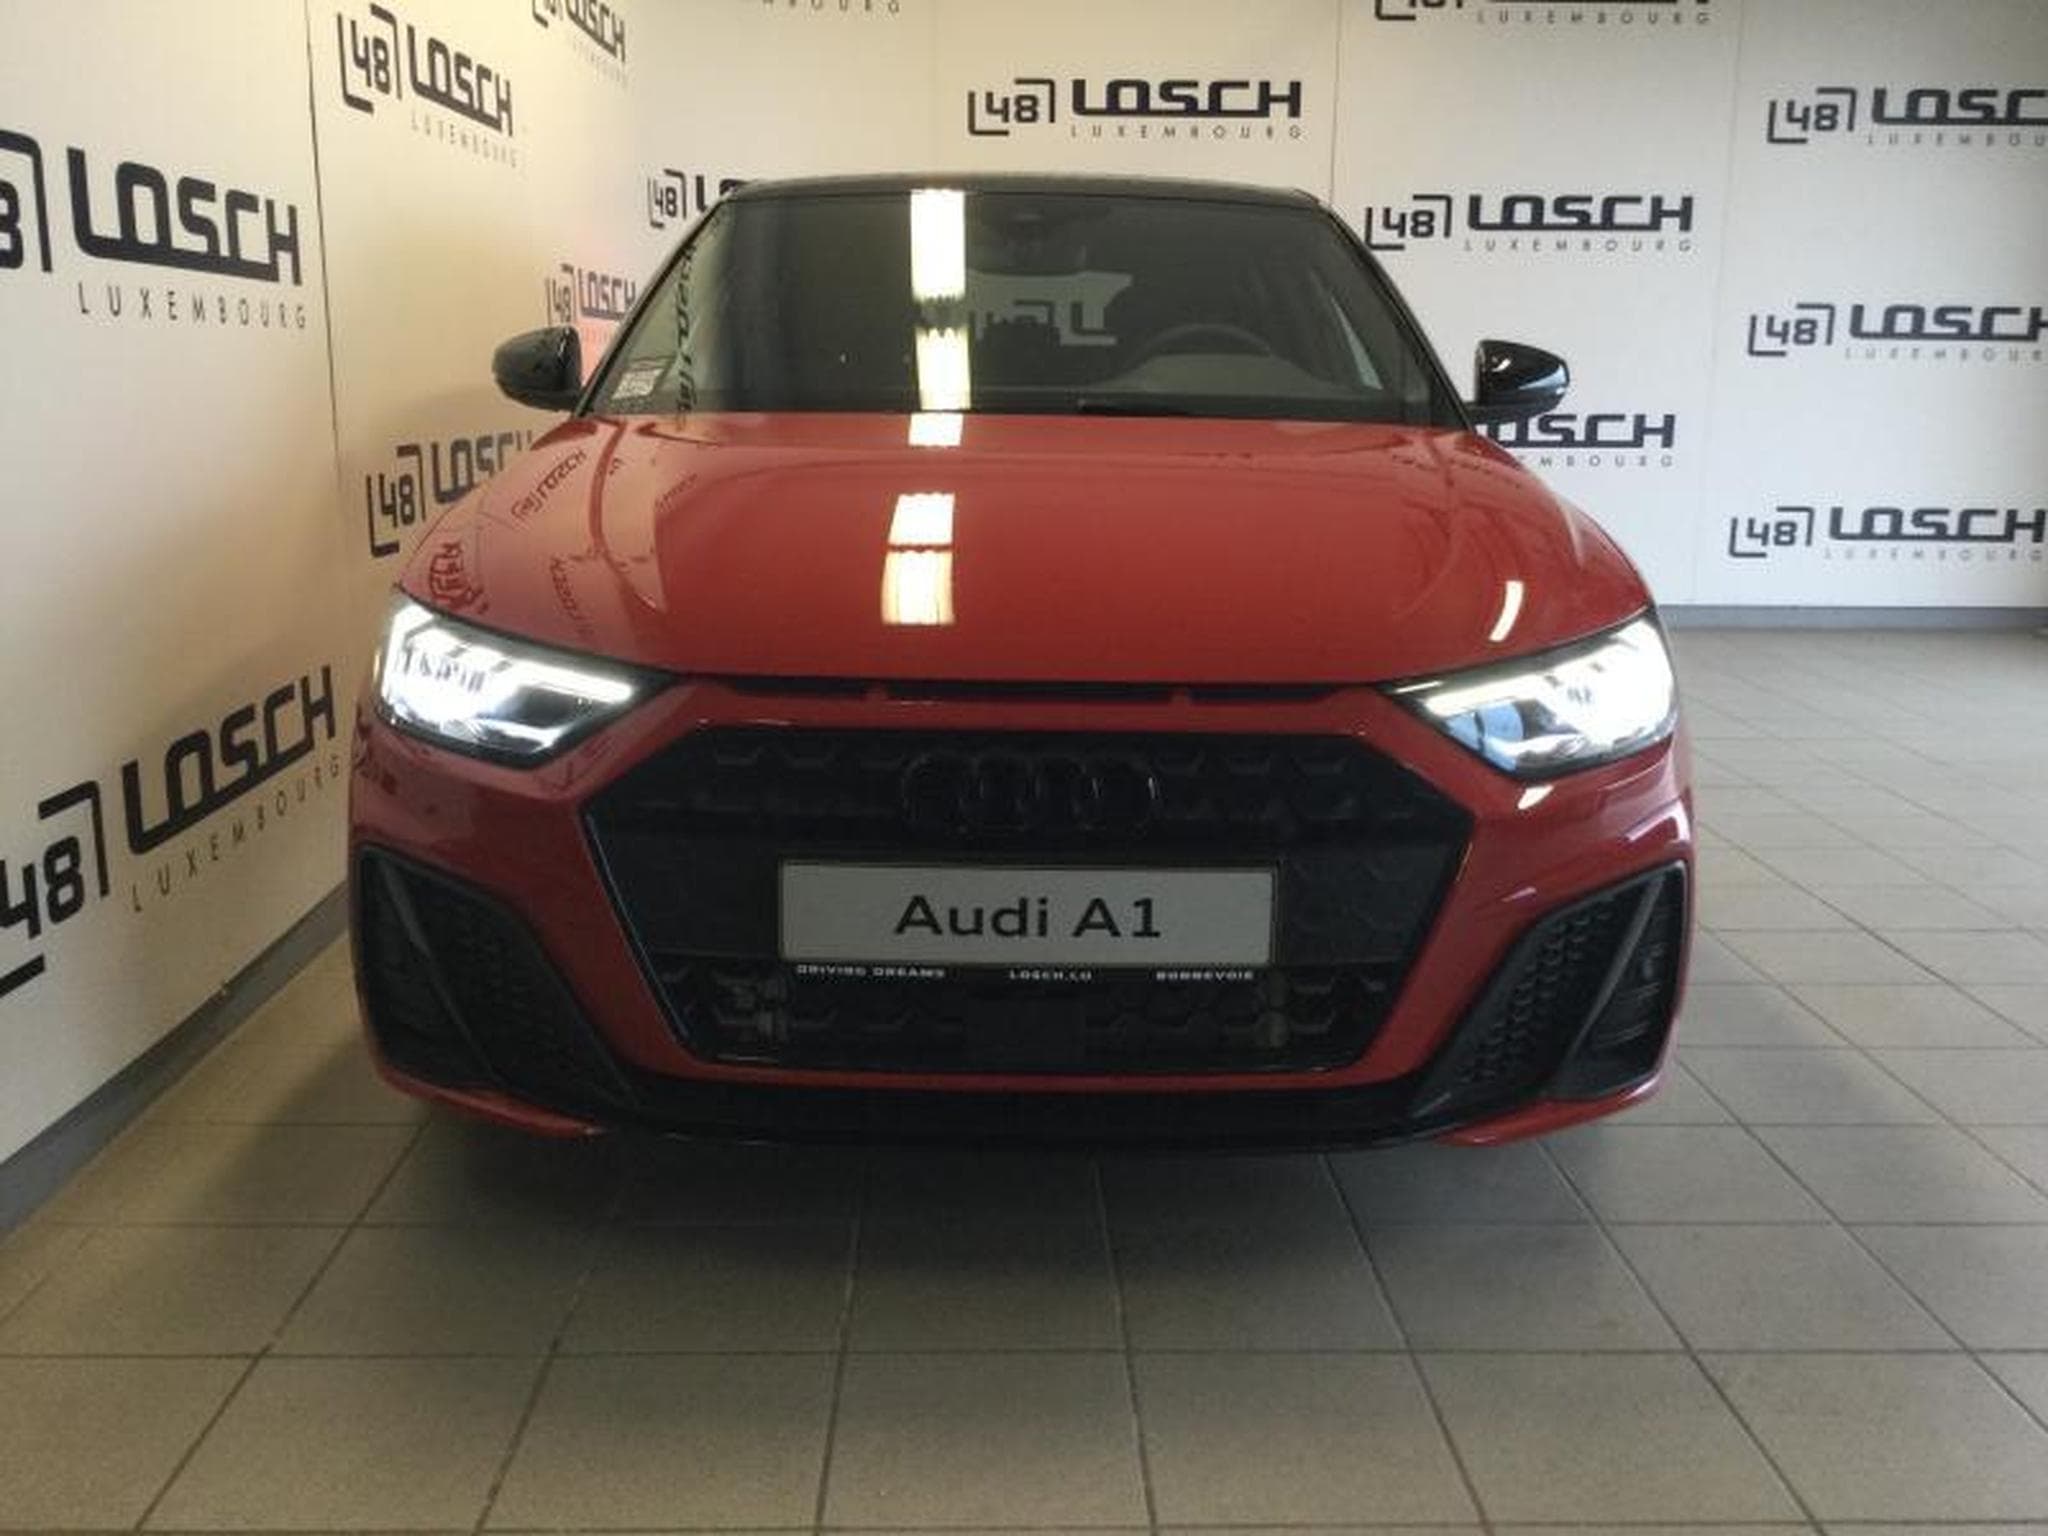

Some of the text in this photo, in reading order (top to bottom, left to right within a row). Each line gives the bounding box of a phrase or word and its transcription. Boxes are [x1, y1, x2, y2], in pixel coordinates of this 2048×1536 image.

[407, 23, 513, 137] LOSCH
[1072, 79, 1302, 118] LOSCH
[1071, 125, 1302, 139] LUXEMBOURG
[67, 146, 302, 286] LOSCH
[1468, 194, 1693, 232] LOSCH
[1464, 239, 1692, 252] LUXEMBOURG
[78, 282, 306, 329] LUXEMBOURG
[1487, 413, 1675, 449] OSCH
[1829, 506, 2046, 543] LOSCH
[122, 664, 336, 856] LOSCH
[131, 754, 341, 912] LUXEMBOURG
[894, 894, 1162, 939] Audi A1
